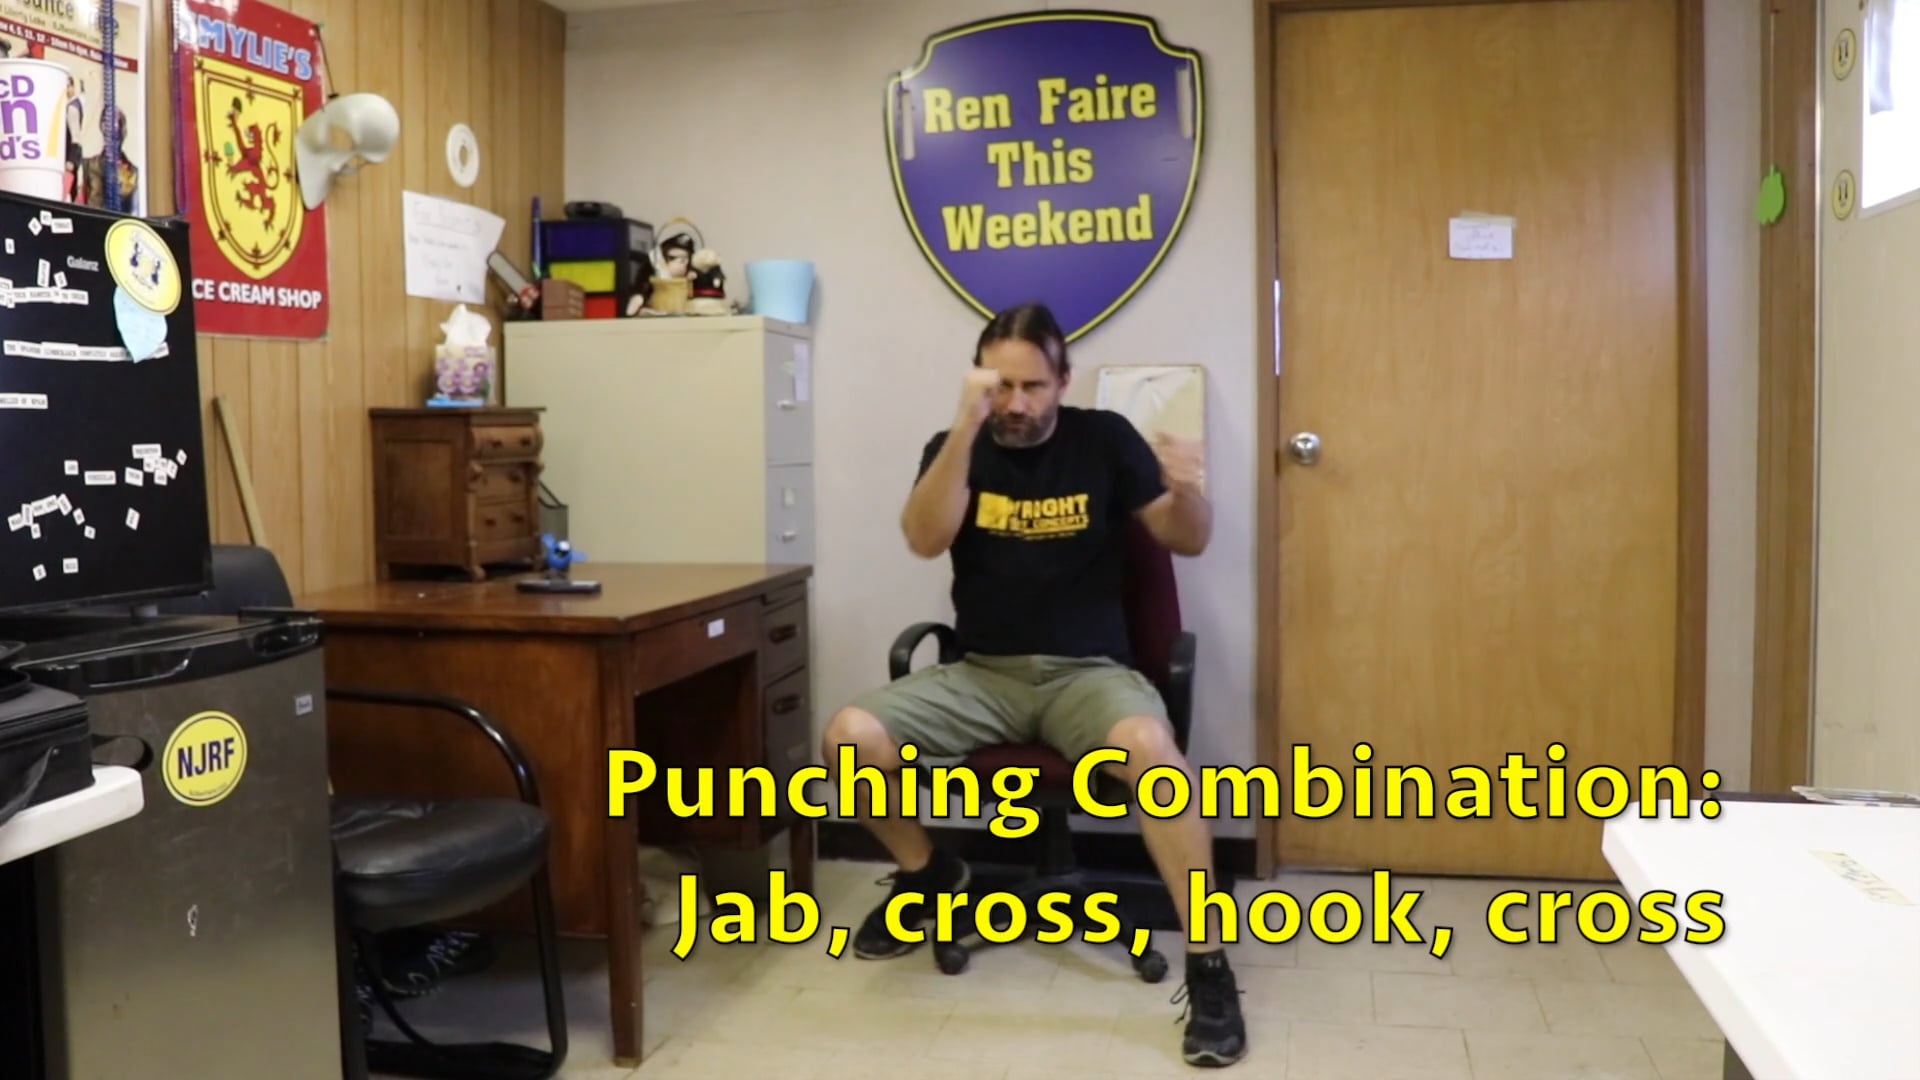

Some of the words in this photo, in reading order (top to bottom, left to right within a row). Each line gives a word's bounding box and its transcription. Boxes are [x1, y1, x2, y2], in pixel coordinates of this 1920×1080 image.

[197, 14, 312, 80] MYLIE'S
[923, 87, 1012, 134] Ren
[1038, 74, 1157, 125] Faire
[987, 138, 1095, 188] This
[941, 193, 1153, 251] Weekend
[191, 278, 215, 300] CE
[218, 281, 275, 306] CREAM
[277, 287, 322, 309] SHOP
[177, 737, 235, 780] NJRF
